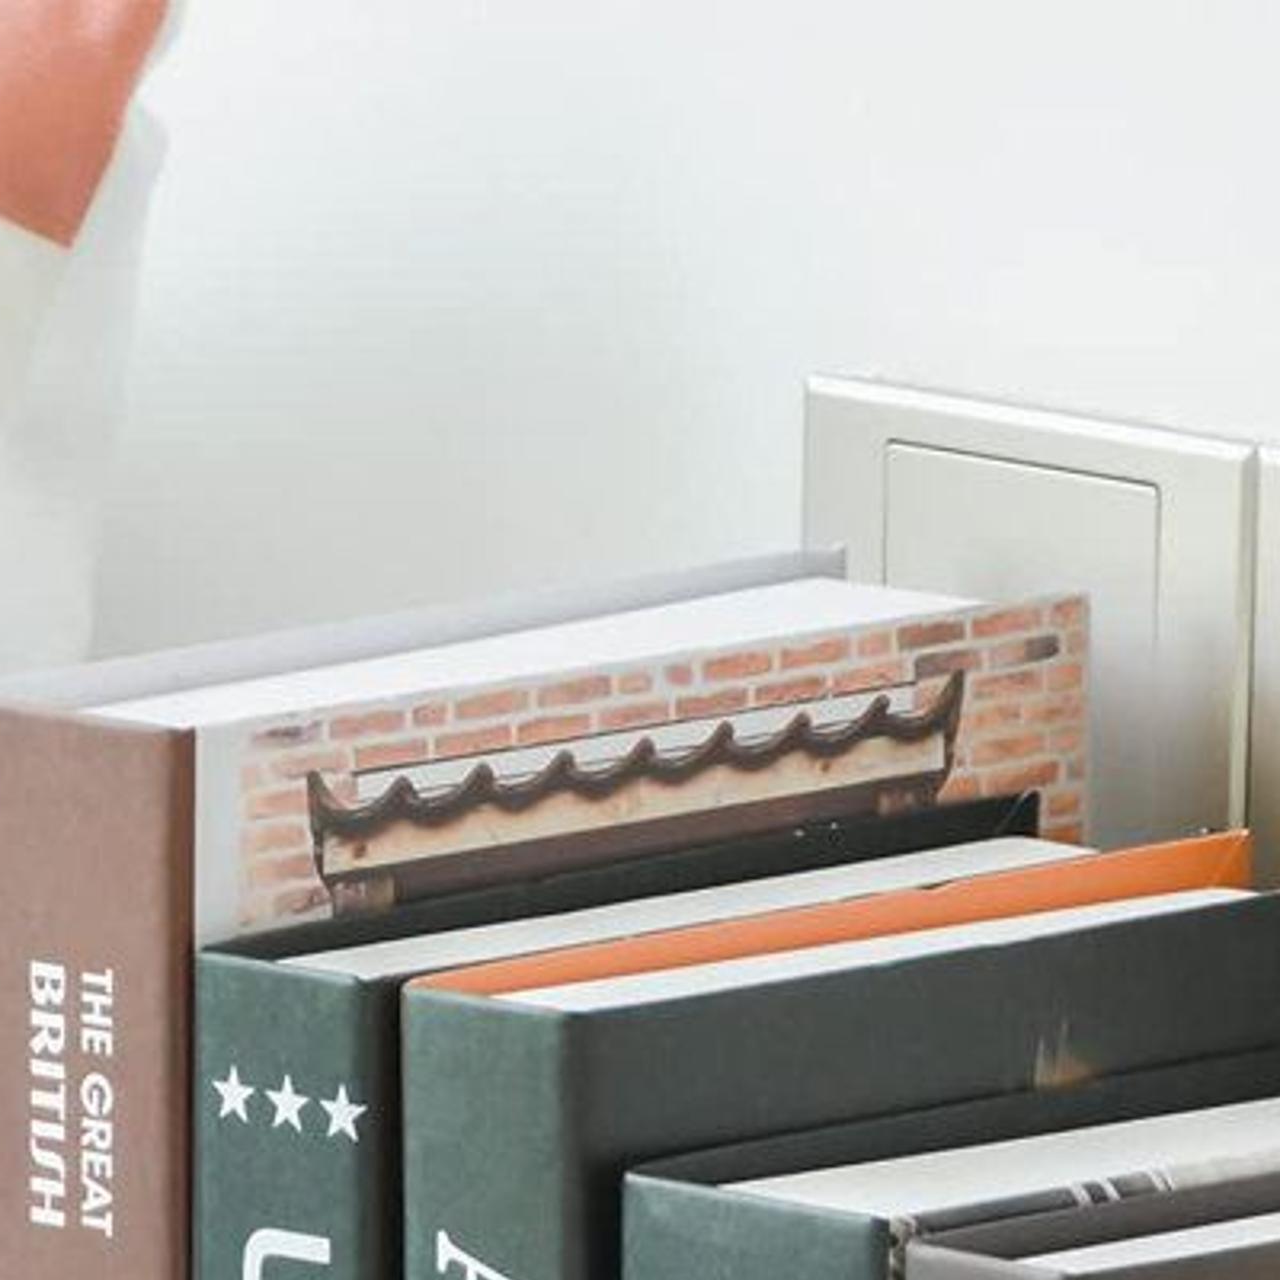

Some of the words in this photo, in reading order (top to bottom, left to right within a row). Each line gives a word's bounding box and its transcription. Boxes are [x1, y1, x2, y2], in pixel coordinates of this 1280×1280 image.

[29, 960, 66, 1227] BRITISH
[81, 969, 113, 1056] THE
[80, 1072, 114, 1237] GREAT
